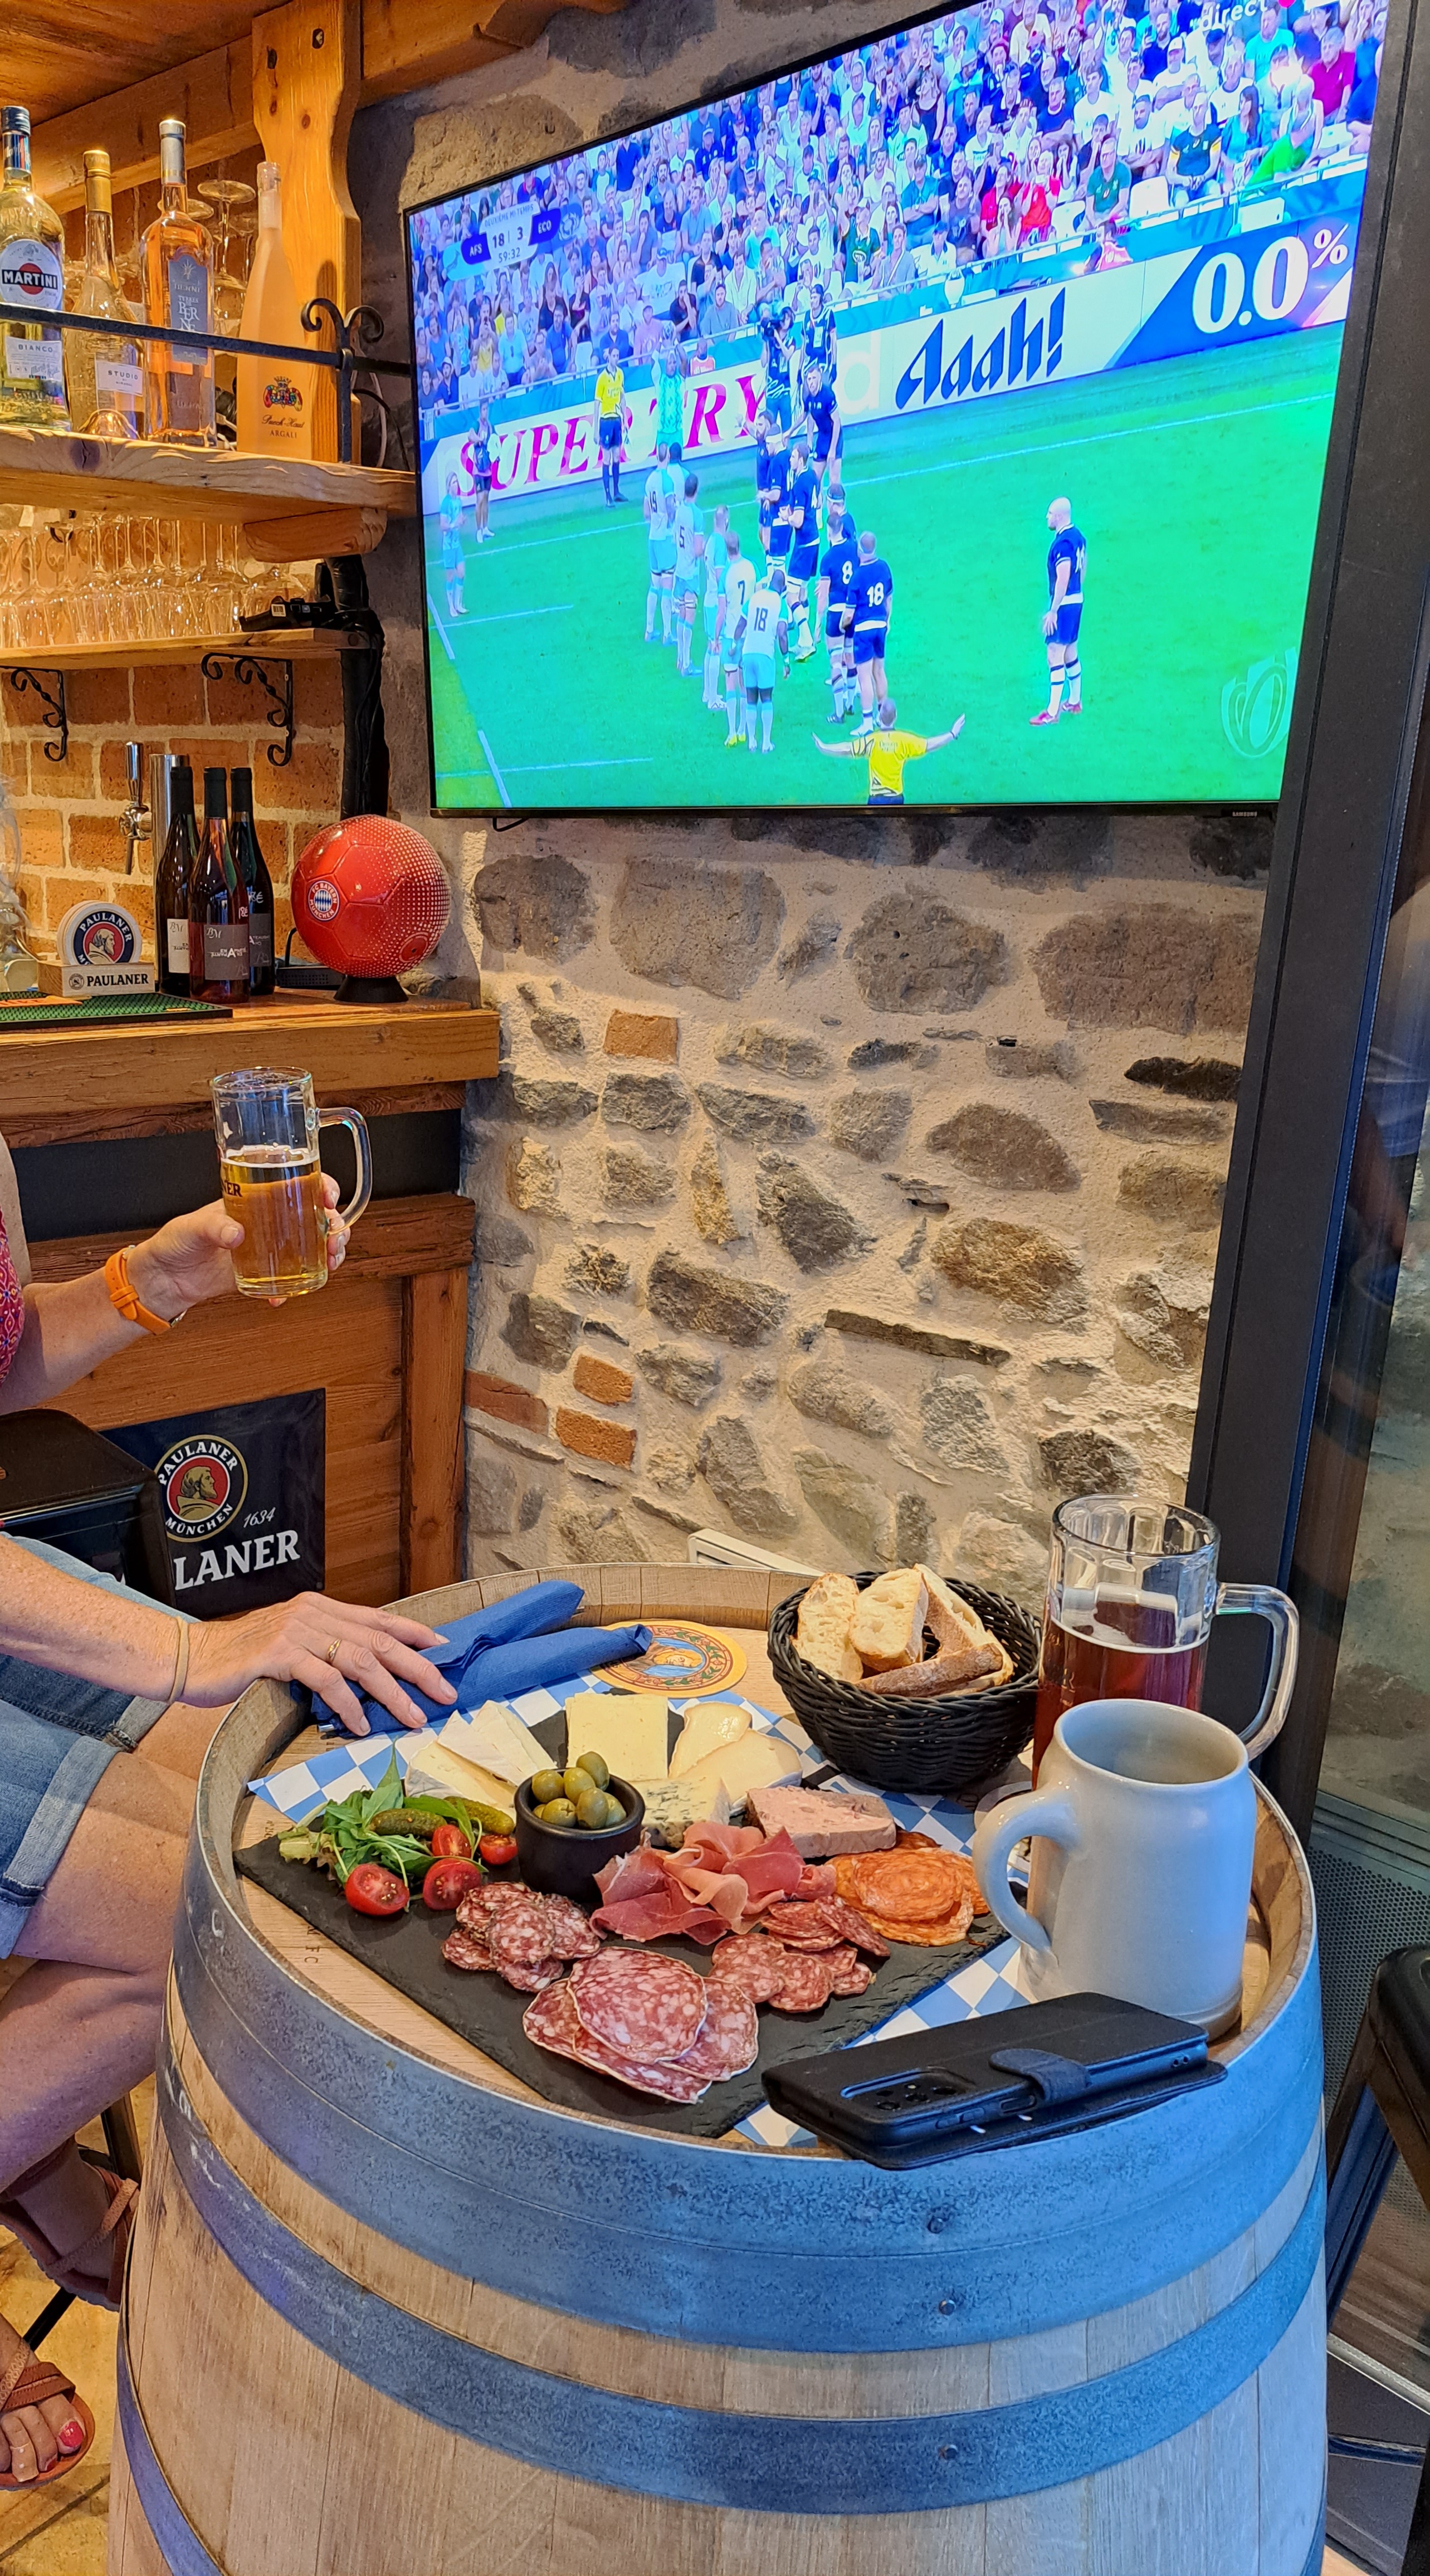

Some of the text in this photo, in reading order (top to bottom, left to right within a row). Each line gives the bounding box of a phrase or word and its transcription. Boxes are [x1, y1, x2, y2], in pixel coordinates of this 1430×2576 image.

[469, 219, 552, 257] AFS 18 3 ECO
[498, 247, 521, 263] 59:32
[3, 270, 57, 289] MARTINI
[18, 344, 53, 353] BIANCO
[108, 370, 138, 380] STUDIO
[648, 373, 767, 457] RY
[270, 430, 297, 438] ARGALI
[650, 490, 657, 513] 19
[679, 525, 686, 544] 5
[842, 560, 853, 584] 8
[738, 580, 745, 606] 7
[866, 582, 885, 607] 18
[754, 607, 769, 632] 18
[311, 883, 338, 904] FC BAYERN
[79, 913, 132, 942] PAULANER
[86, 974, 149, 987] PAULANER
[158, 1441, 238, 1486] PAULANER
[165, 1503, 233, 1535] MÜNCHEN
[243, 1507, 276, 1528] 1634
[173, 1530, 301, 1591] LANER
